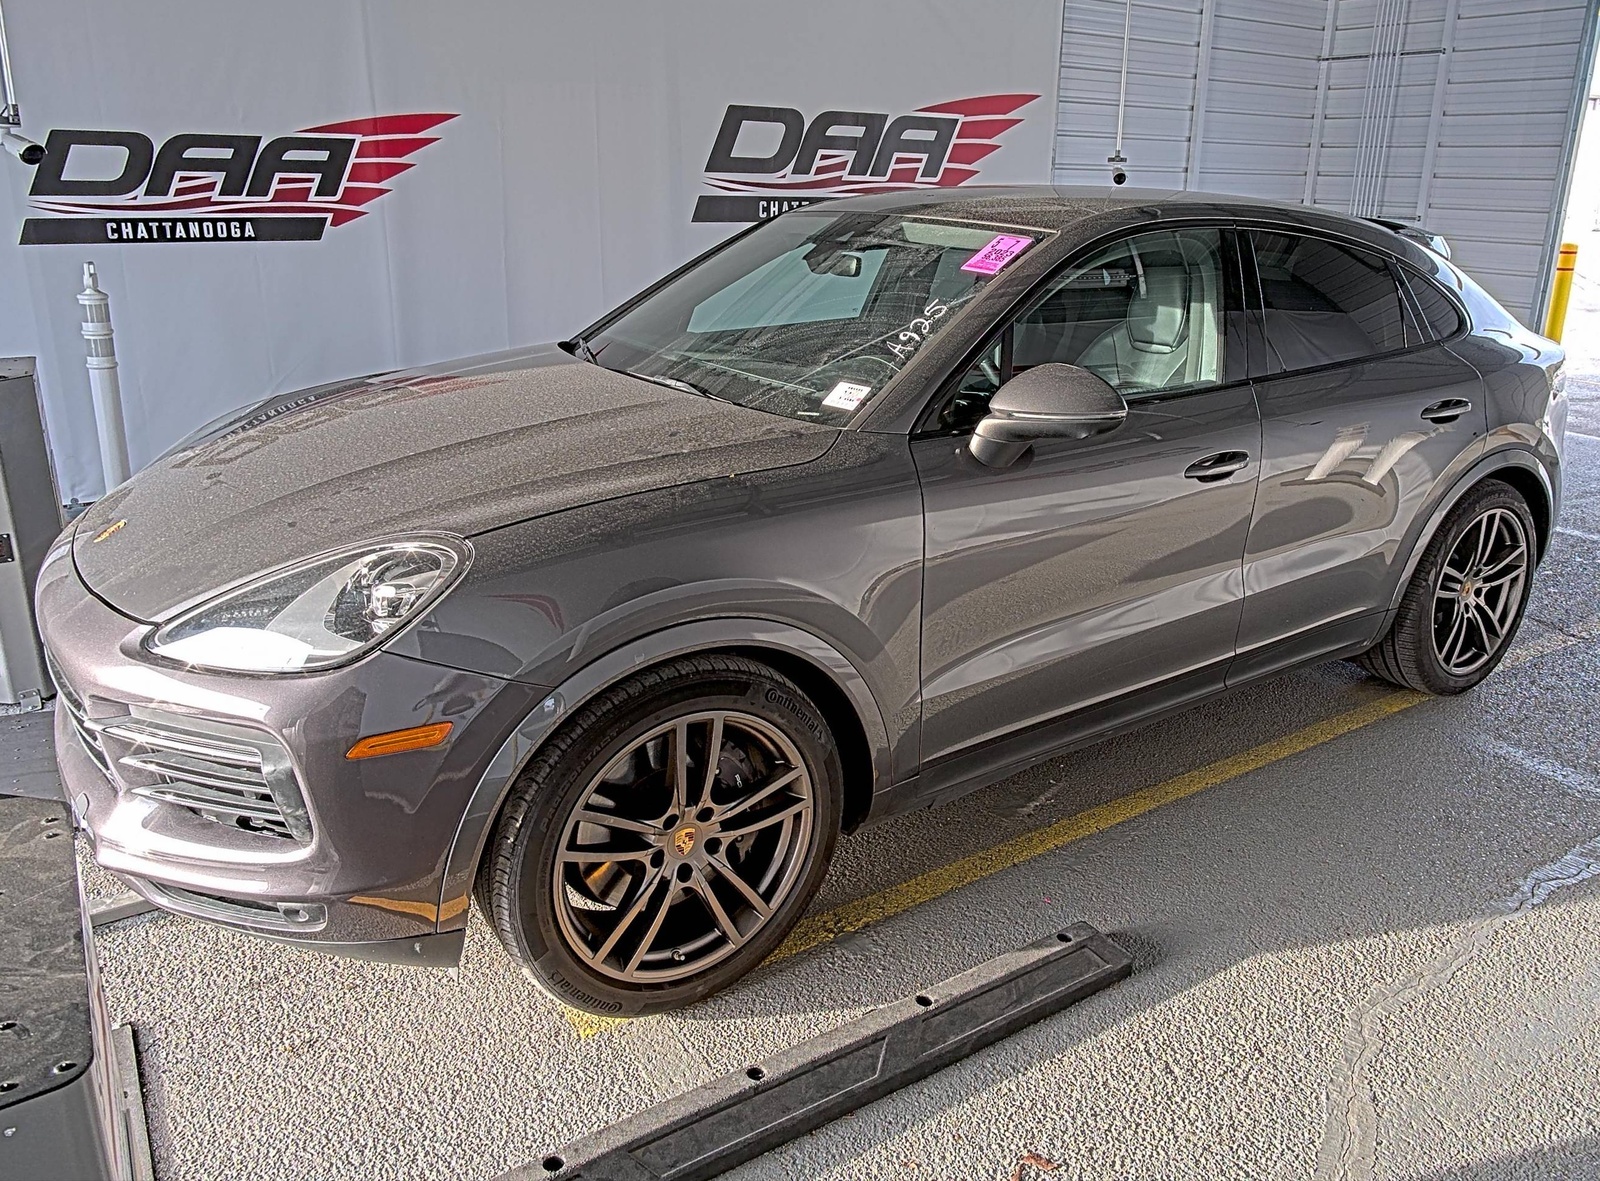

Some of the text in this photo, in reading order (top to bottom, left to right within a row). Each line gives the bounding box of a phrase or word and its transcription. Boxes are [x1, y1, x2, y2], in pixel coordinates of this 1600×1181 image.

[28, 128, 356, 197] DAA
[704, 104, 960, 178] DAA
[105, 220, 256, 240] CHATTANOOGA
[764, 688, 819, 733] Continental
[554, 978, 623, 1013] Continental
